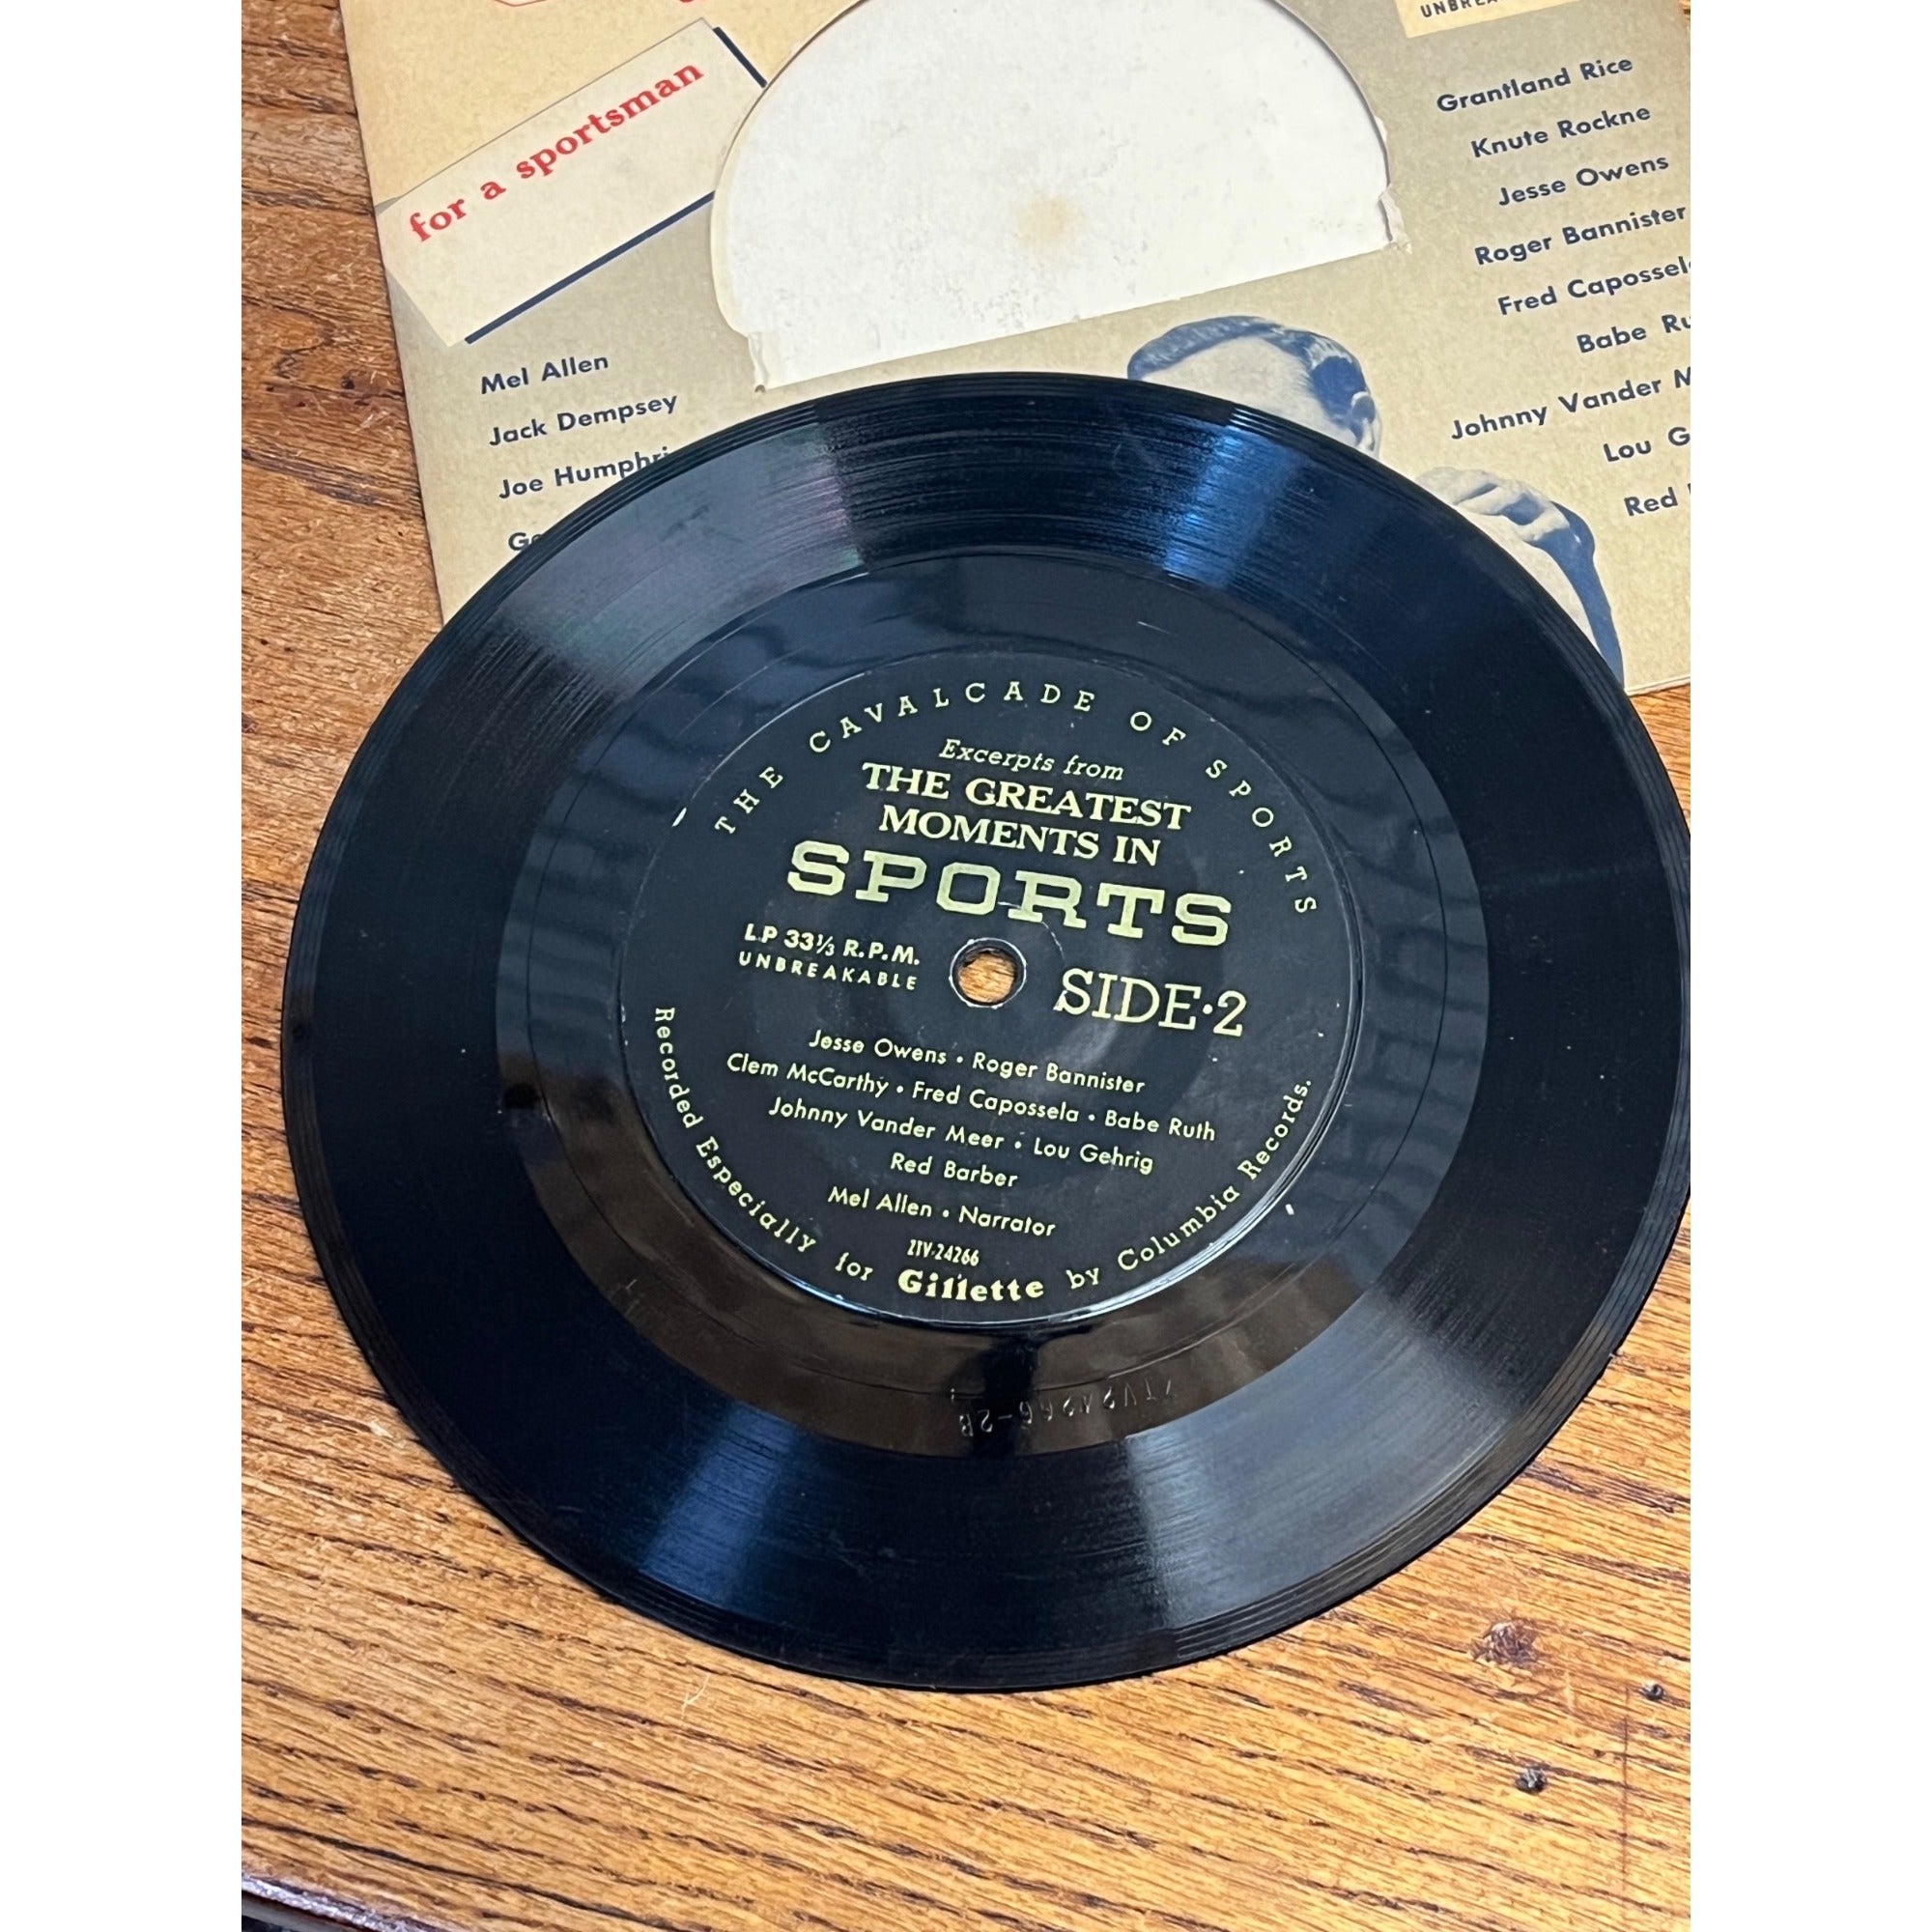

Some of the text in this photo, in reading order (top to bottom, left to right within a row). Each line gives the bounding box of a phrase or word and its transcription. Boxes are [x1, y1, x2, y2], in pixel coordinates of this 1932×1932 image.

[1436, 59, 1633, 112] Grantland Rice
[410, 65, 702, 241] for a sportsman
[1470, 107, 1651, 158] Knute Rockne
[1498, 156, 1669, 206] Jesse Owens
[1474, 207, 1686, 266] Roger Bannister
[1497, 256, 1690, 316] Fred Capossel
[1577, 326, 1647, 354] Babe
[481, 356, 609, 395] Mel Allen
[489, 395, 677, 446] Jack Dempsey
[1451, 406, 1548, 440] Johnny
[1557, 380, 1662, 412] Vander
[1603, 440, 1652, 463] Lou
[498, 478, 543, 499] Joe
[1624, 486, 1678, 517] Red
[938, 738, 1124, 781] Excerpts from
[714, 681, 1318, 914] THE CAVALCADE OF SPORTS
[862, 761, 1192, 830] THE GREATEST
[878, 804, 1161, 867] MOMENTS IN
[786, 839, 1232, 947] SPORTS
[738, 951, 918, 991] UNBREAKABLE
[842, 938, 921, 966] R.P.M.
[809, 1029, 1146, 1094] Jesse Owens Roger Bannister
[726, 1052, 1215, 1142] Clem McCarthy Fred Capossela Babe Ruth
[654, 1007, 1312, 1302] Recorded Especially for Gillette by Columbia Records.
[768, 1096, 1153, 1176] Johnny Vander Meer Lou Gehrig
[890, 1151, 1018, 1187] Red Barber
[827, 1185, 1056, 1236] Mel Allen Narrator
